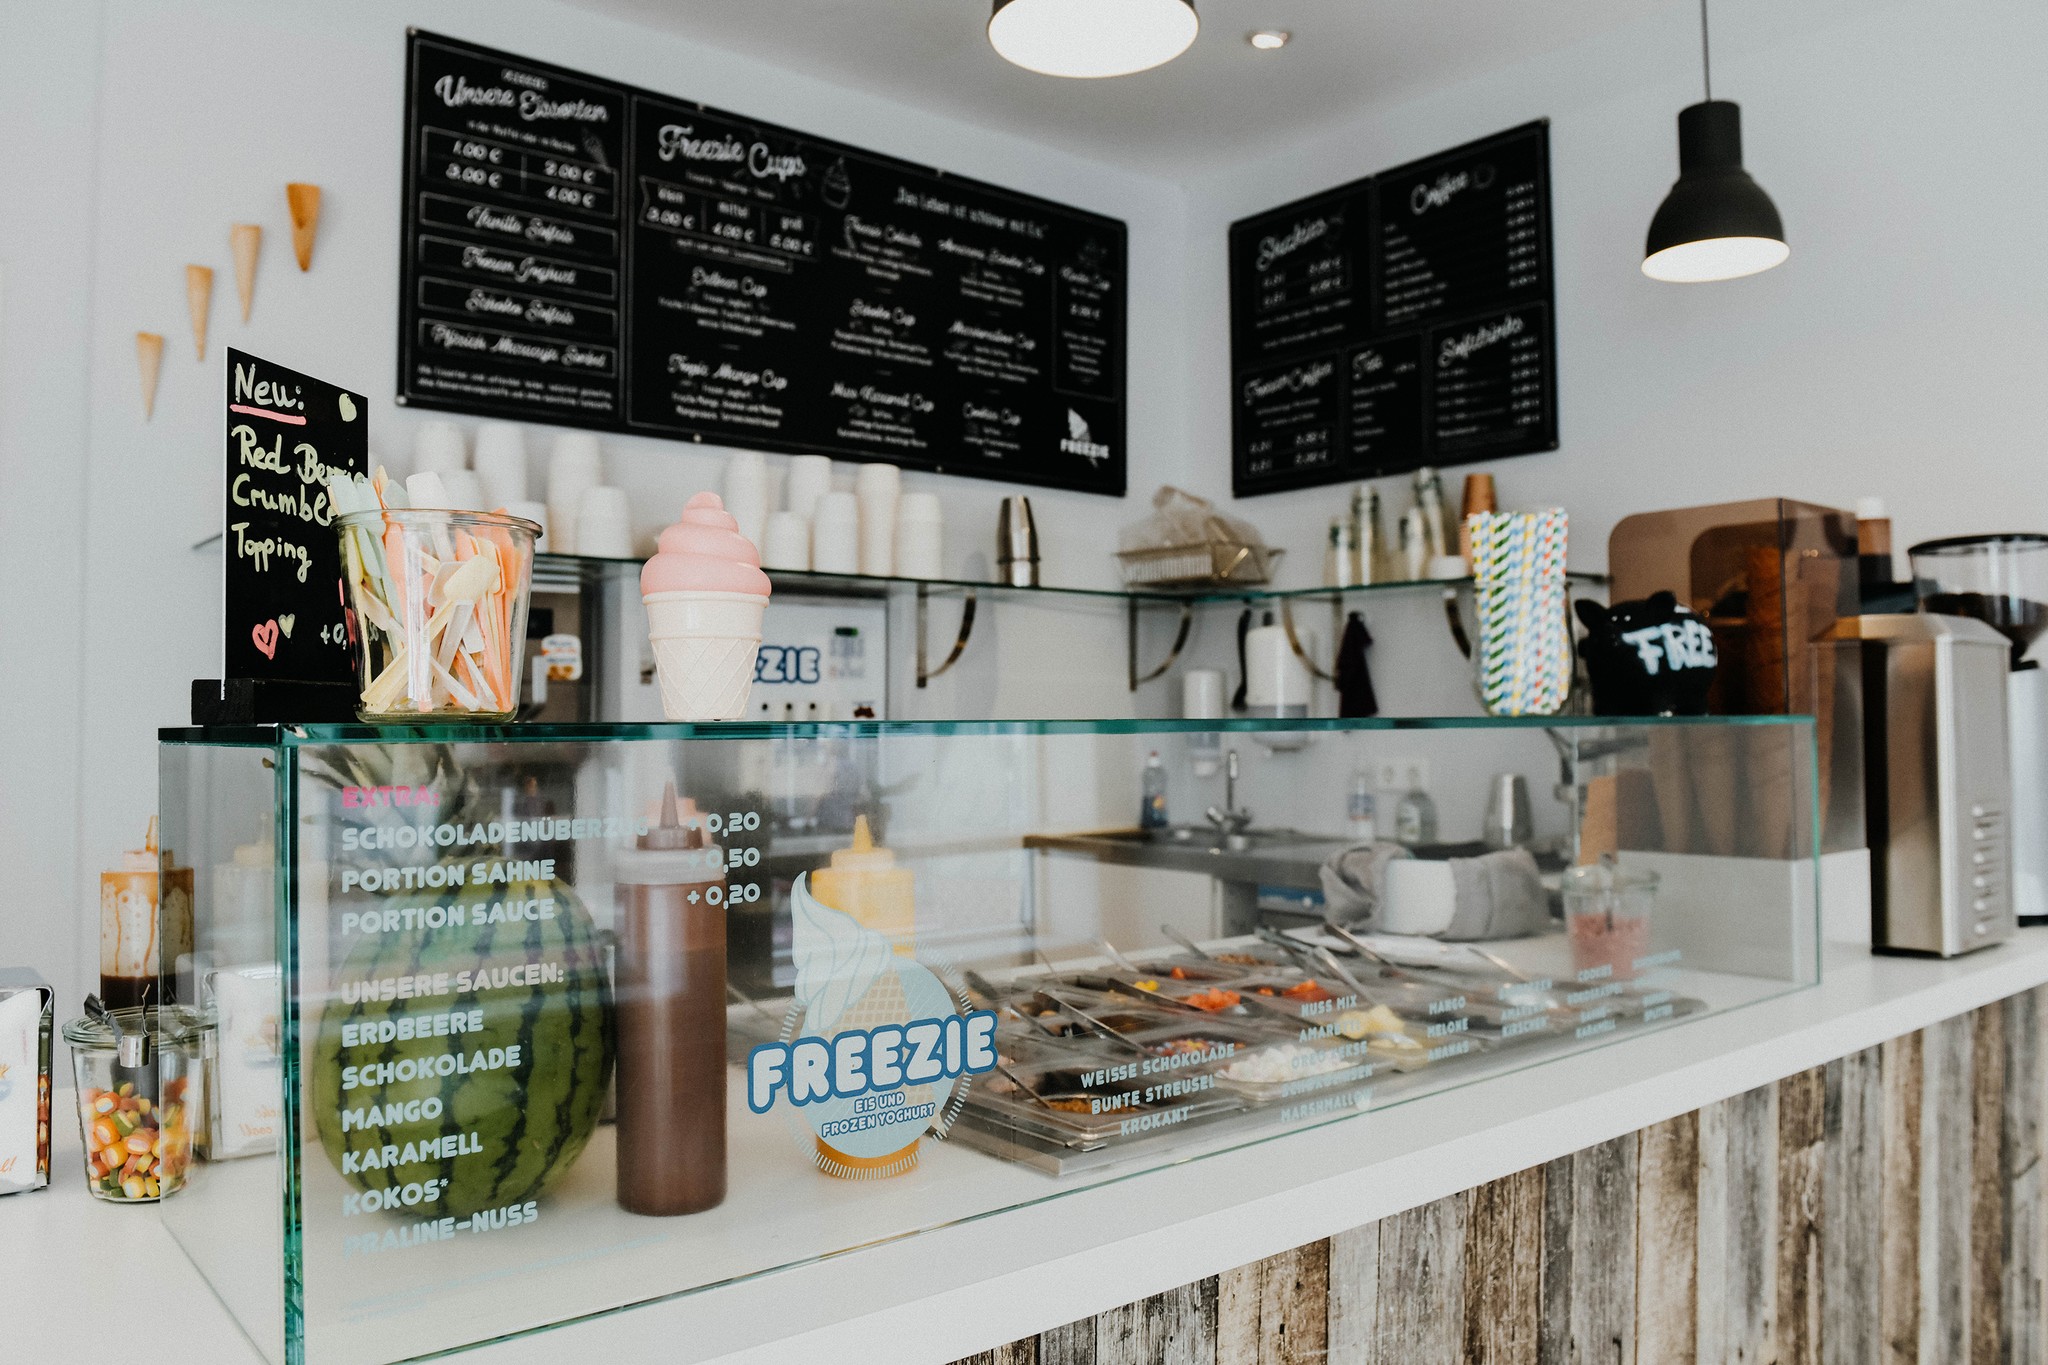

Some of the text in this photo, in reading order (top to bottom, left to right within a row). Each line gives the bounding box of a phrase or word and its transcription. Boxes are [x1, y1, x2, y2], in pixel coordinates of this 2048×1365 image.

[434, 75, 515, 107] Unsere
[658, 124, 807, 183] Freezie Cups
[235, 363, 304, 410] Neu:
[231, 424, 291, 475] Red
[231, 522, 312, 583] Topping
[753, 645, 820, 684] ZIE
[342, 785, 440, 809] EXTRA:
[342, 816, 648, 851] SCHOKOLADENÜBERZUG
[342, 863, 465, 893] PORTION
[472, 858, 556, 885] SAHNE
[342, 905, 465, 936] PORTION
[472, 898, 556, 924] SAUCE
[341, 962, 564, 1005] UNSERE SAUCEN:
[1301, 994, 1357, 1017] NUSS MIX
[1428, 995, 1466, 1015] MANGO
[342, 1009, 484, 1048] ERDBEERE
[1427, 1017, 1469, 1038] MELONE
[342, 1044, 521, 1090] SCHOKOLADE
[748, 1009, 999, 1114] FREEZIE
[1081, 1042, 1235, 1089] WEISSE SCHOKOLADE
[342, 1096, 443, 1133] MANGO
[854, 1091, 906, 1114] EIS UND
[1091, 1074, 1216, 1116] BUNTE STREUSEL
[821, 1102, 936, 1138] FROZEN YOGHURT
[342, 1131, 483, 1175] KARAMELL
[343, 1200, 538, 1262] PRALINE-NUSS
